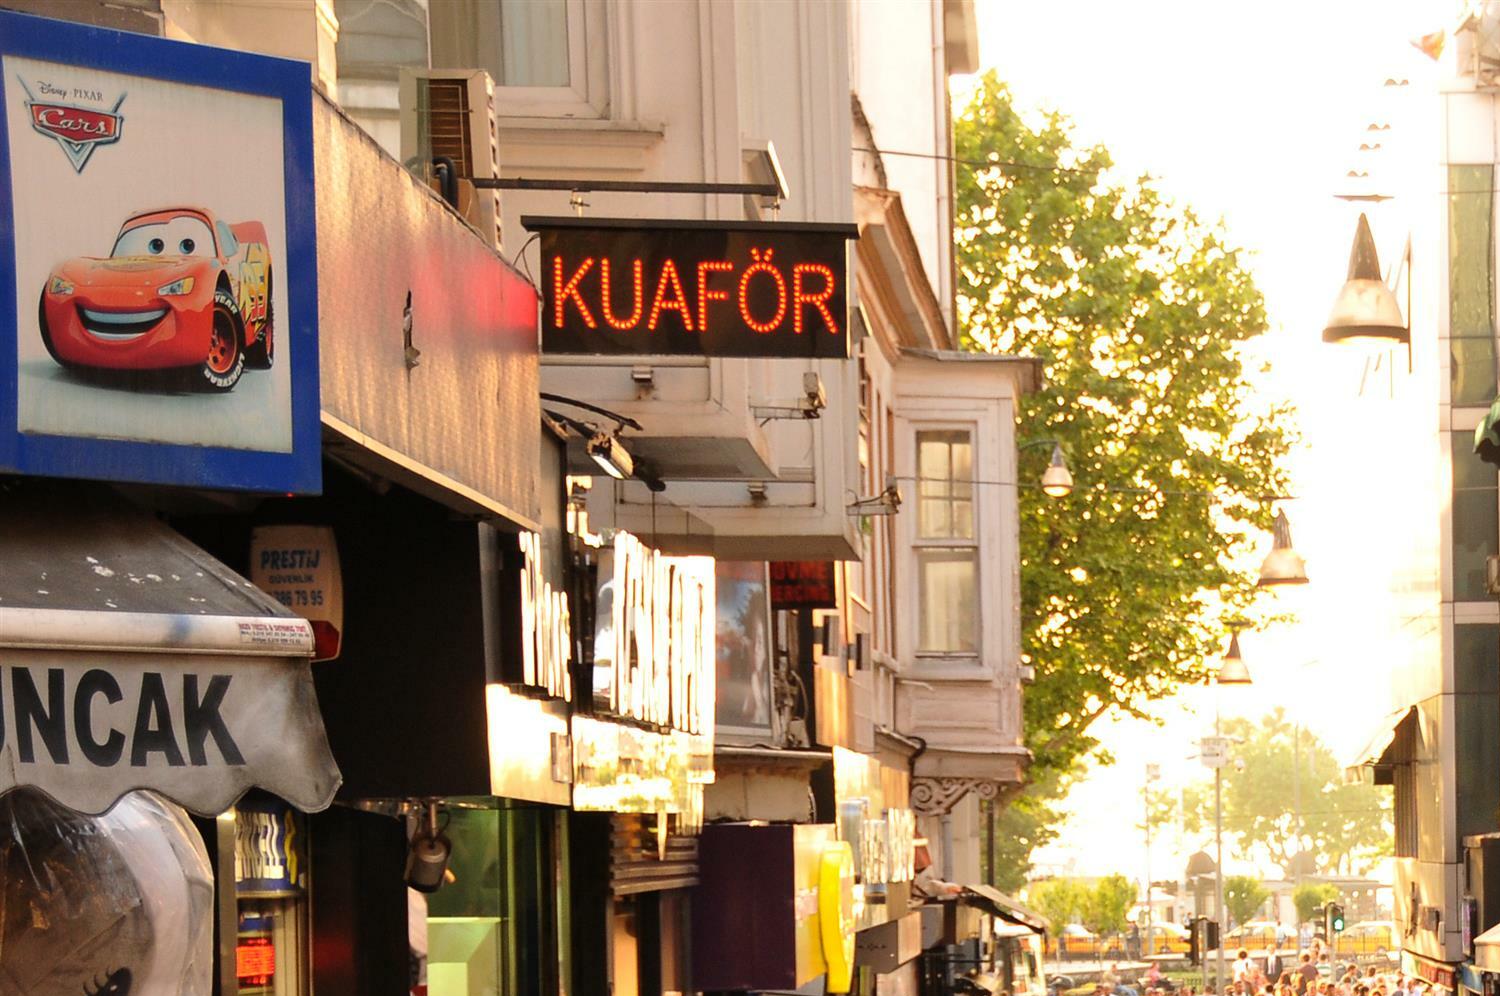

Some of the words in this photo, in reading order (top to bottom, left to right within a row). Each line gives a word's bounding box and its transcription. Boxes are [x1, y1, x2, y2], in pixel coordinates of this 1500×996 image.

[37, 80, 67, 99] Disney
[73, 88, 103, 101] PIXAR
[39, 109, 110, 135] Cars
[554, 247, 838, 333] KUAFÖR
[0, 666, 246, 767] NCAK
